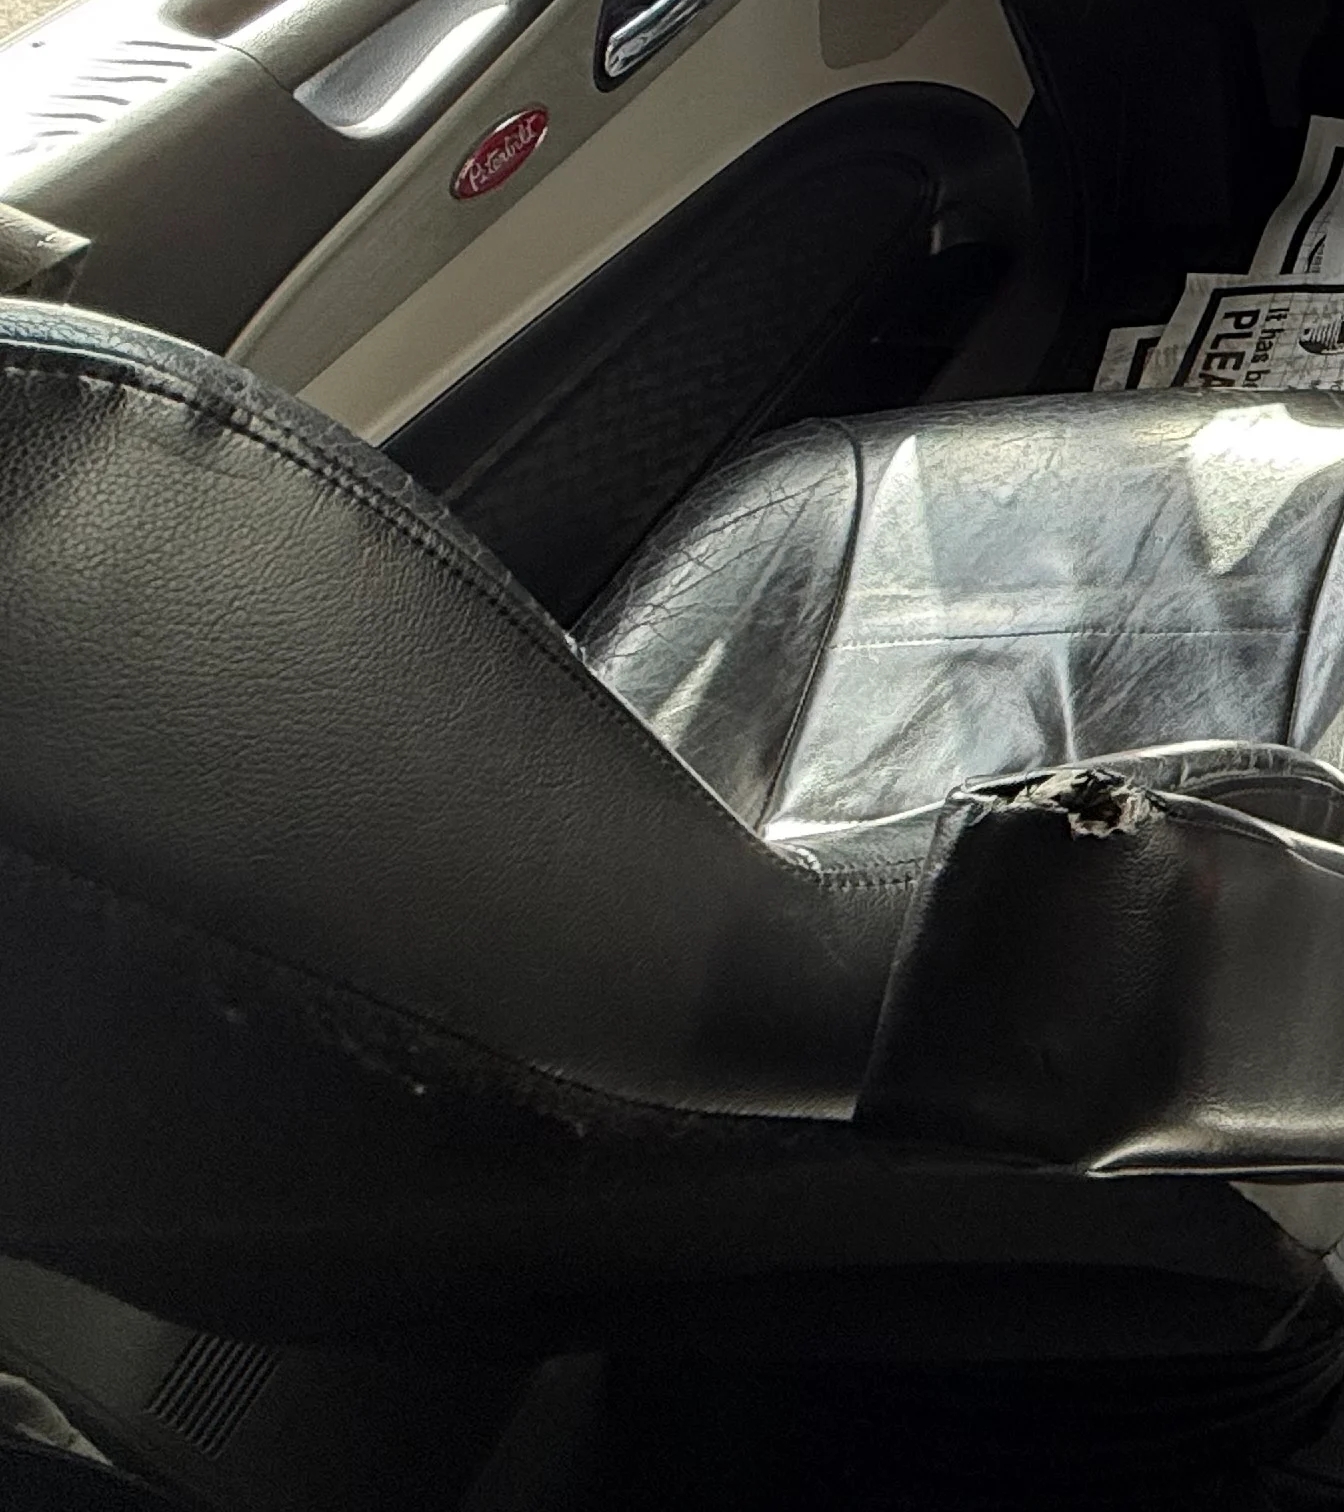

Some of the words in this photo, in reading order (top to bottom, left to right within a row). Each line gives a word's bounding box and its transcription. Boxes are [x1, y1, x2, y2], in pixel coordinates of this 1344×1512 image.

[1265, 307, 1290, 321] It
[1198, 309, 1260, 387] PLEA
[1250, 327, 1285, 368] has
